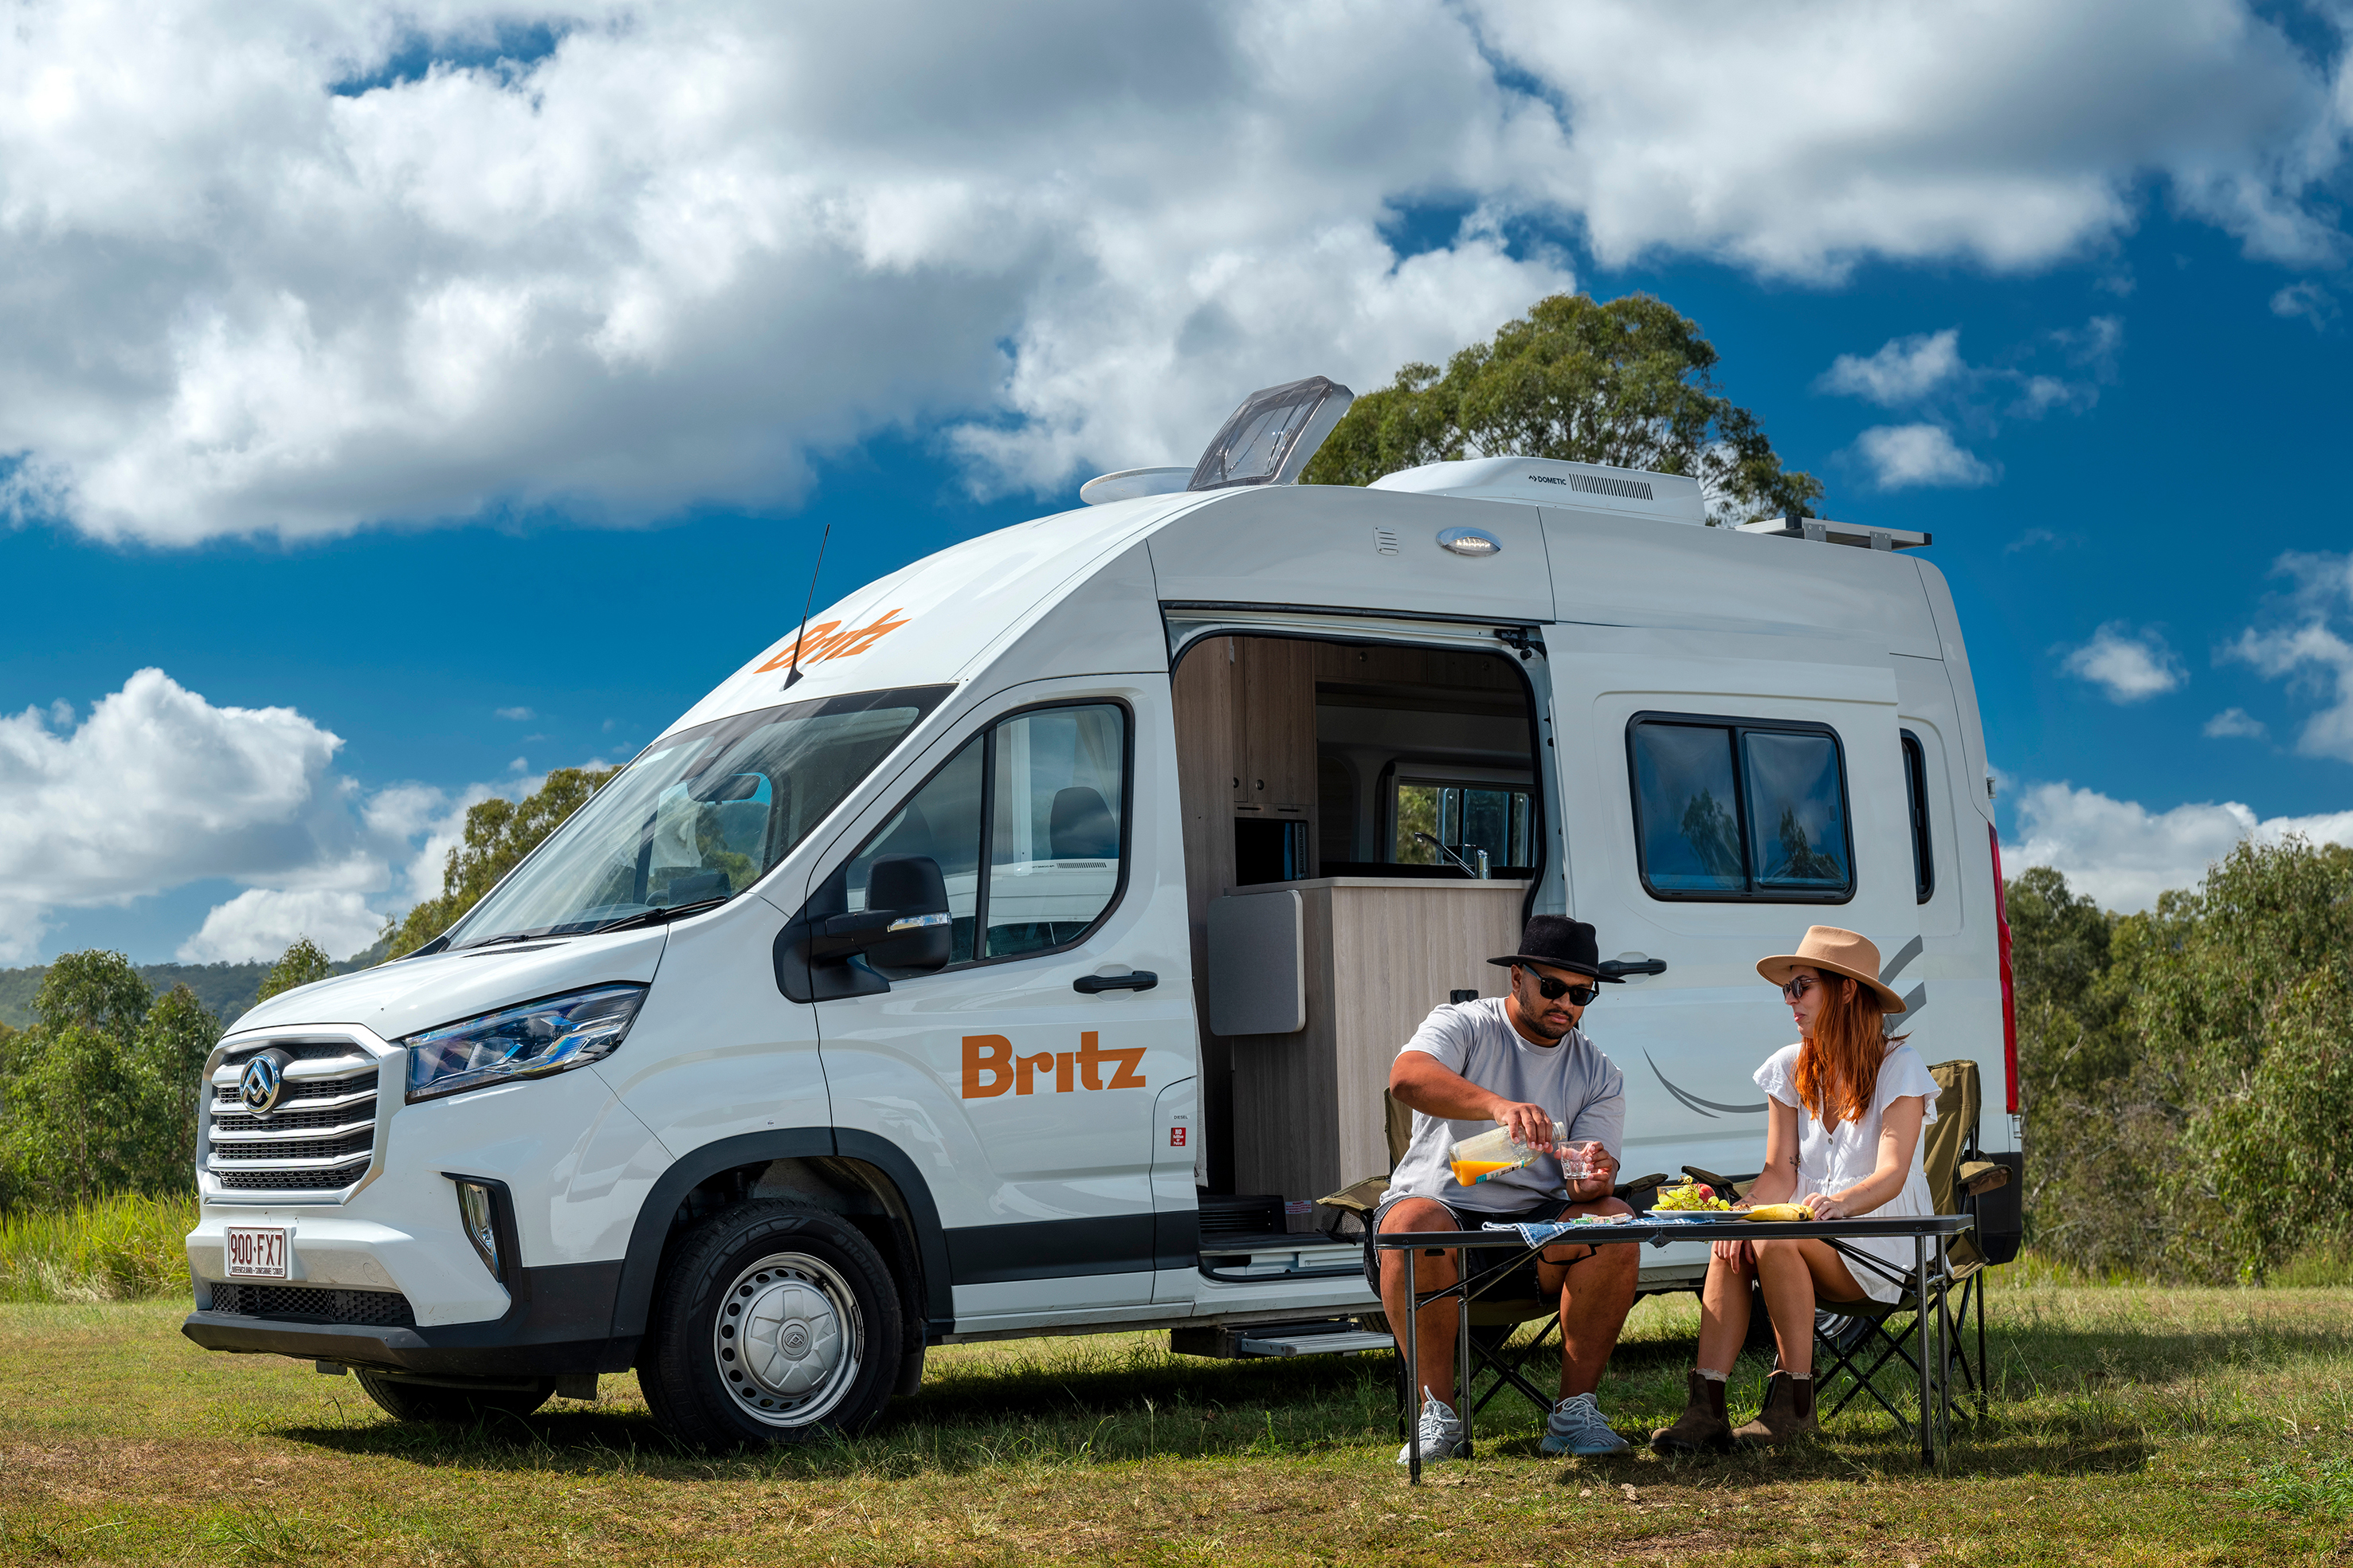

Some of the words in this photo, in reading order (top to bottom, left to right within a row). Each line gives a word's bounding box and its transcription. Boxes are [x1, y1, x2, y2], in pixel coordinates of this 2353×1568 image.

[1538, 476, 1567, 485] DOMETIC
[752, 607, 912, 674] Britz
[962, 1031, 1147, 1099] Britz
